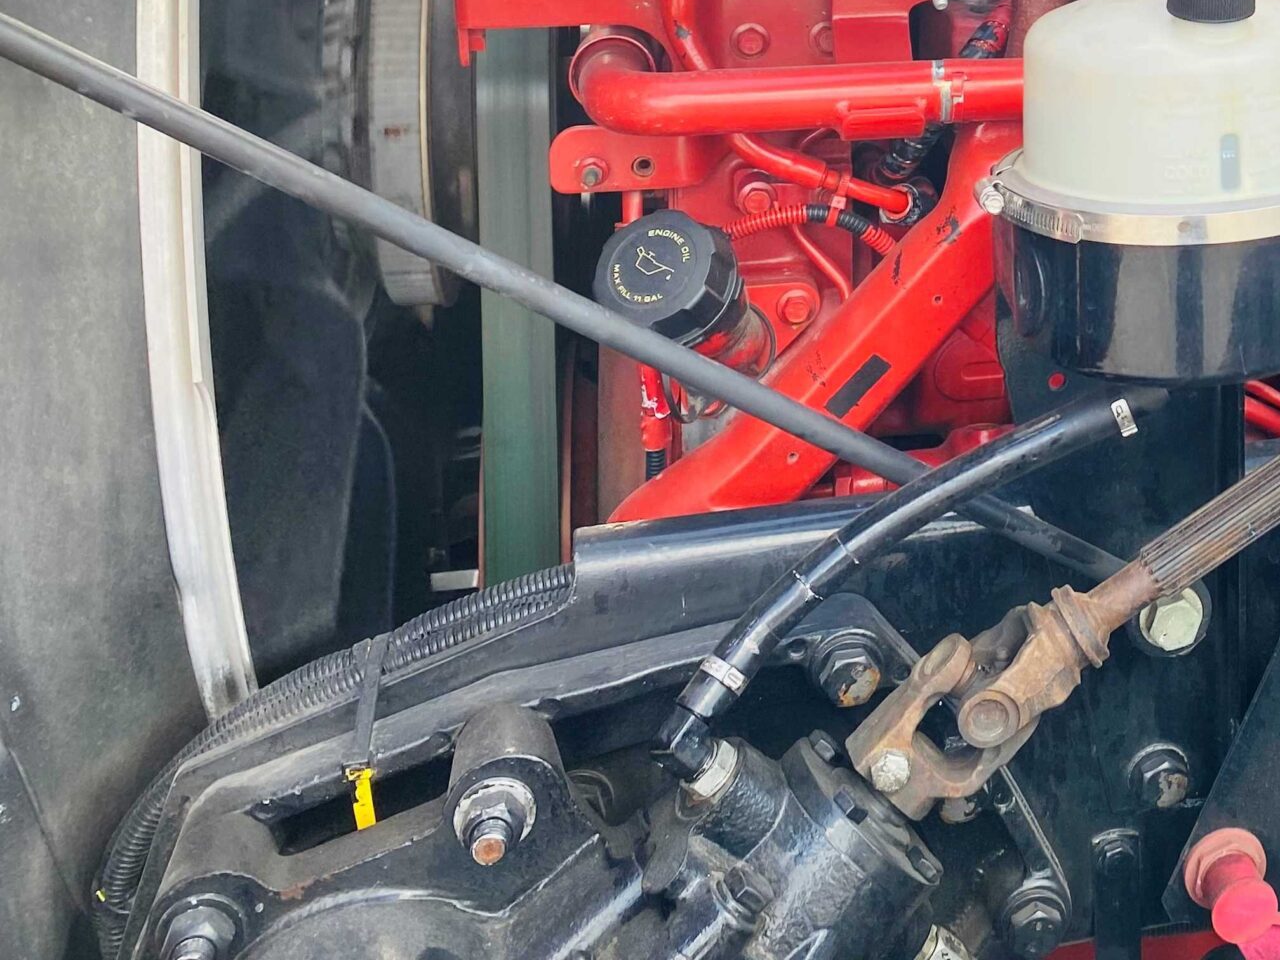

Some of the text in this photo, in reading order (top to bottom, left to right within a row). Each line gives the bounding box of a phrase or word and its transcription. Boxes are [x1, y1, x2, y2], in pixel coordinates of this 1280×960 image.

[648, 229, 691, 263] ENGINE OIL
[613, 264, 622, 287] MAX
[617, 285, 632, 300] FILL
